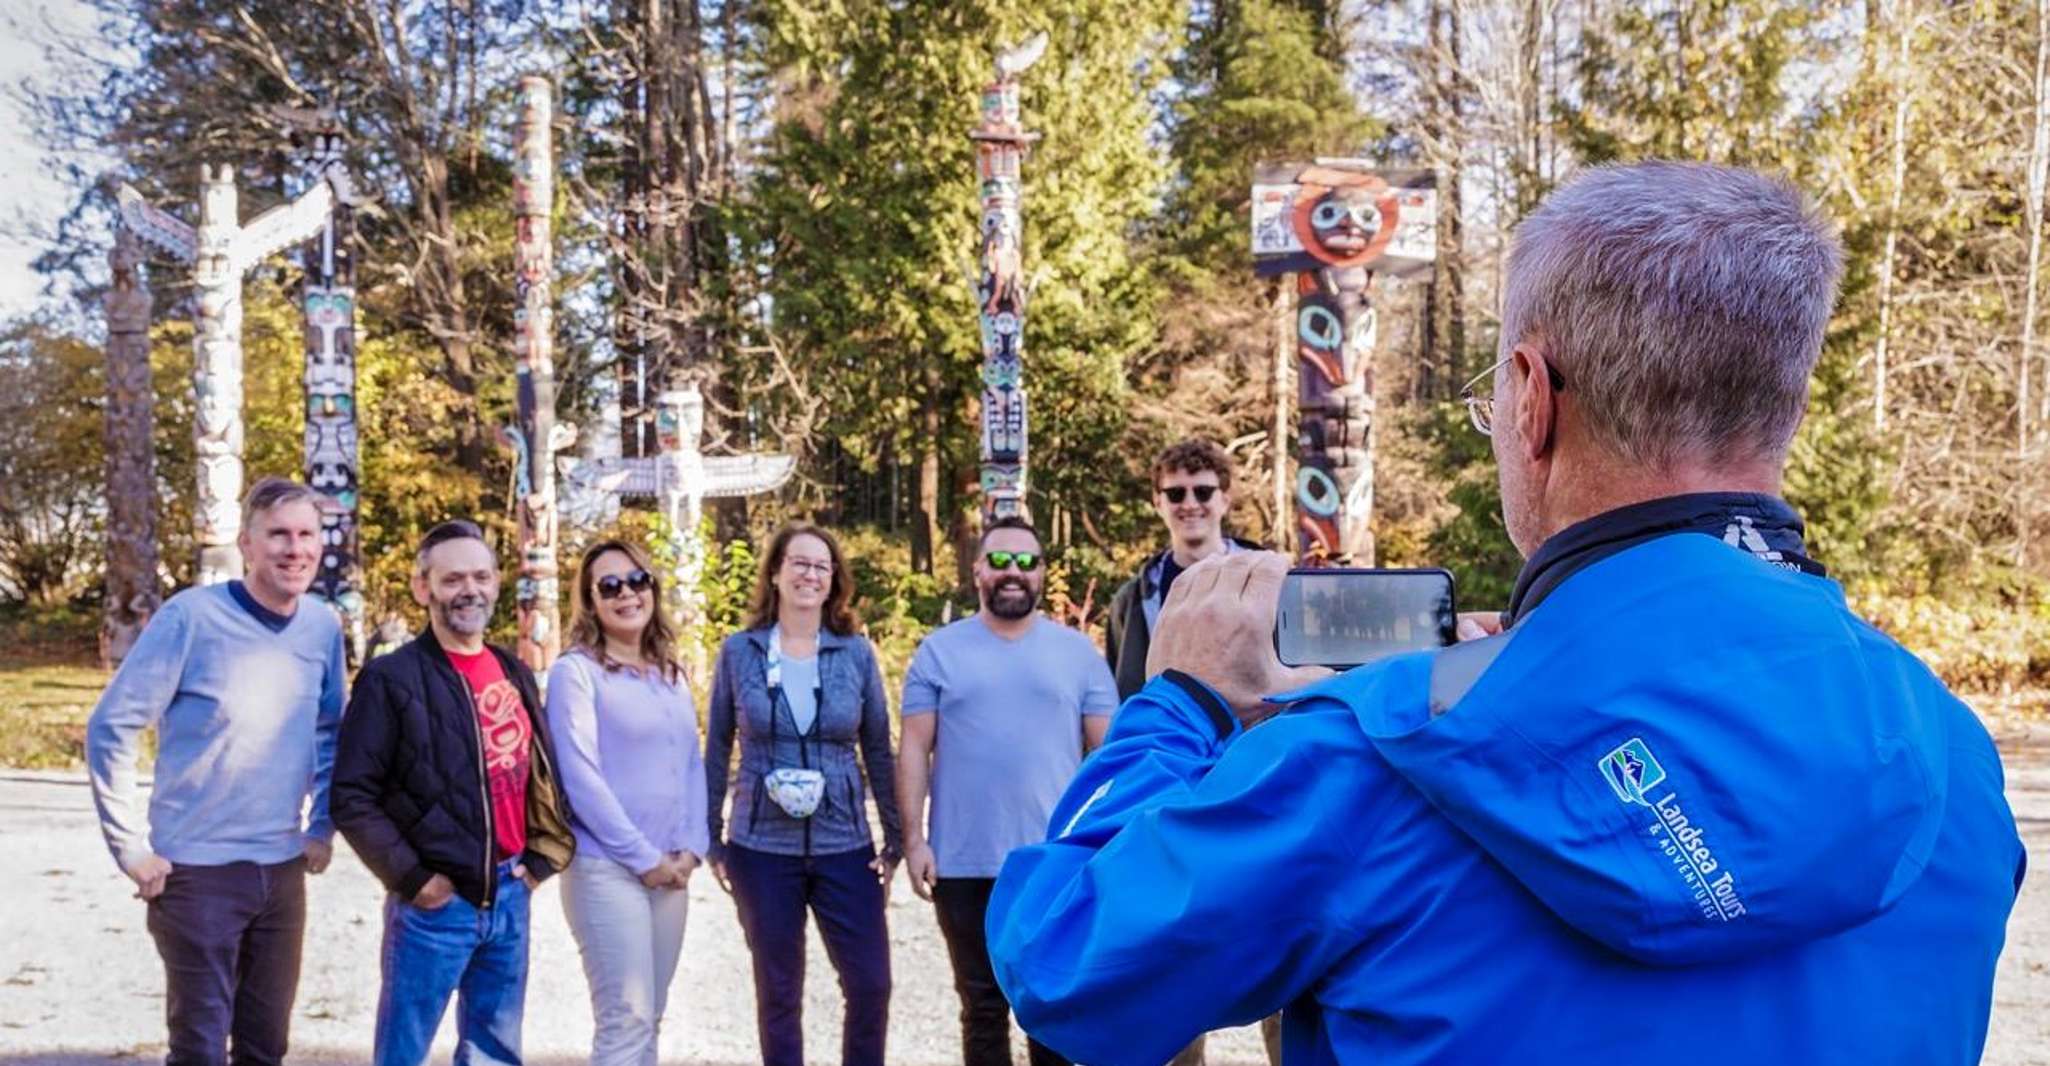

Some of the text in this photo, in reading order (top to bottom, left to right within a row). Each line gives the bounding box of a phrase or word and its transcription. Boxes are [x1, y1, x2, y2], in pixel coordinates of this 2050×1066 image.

[1649, 822, 1718, 919] & ADVENTURES
[1655, 793, 1746, 918] Landsea Tours
